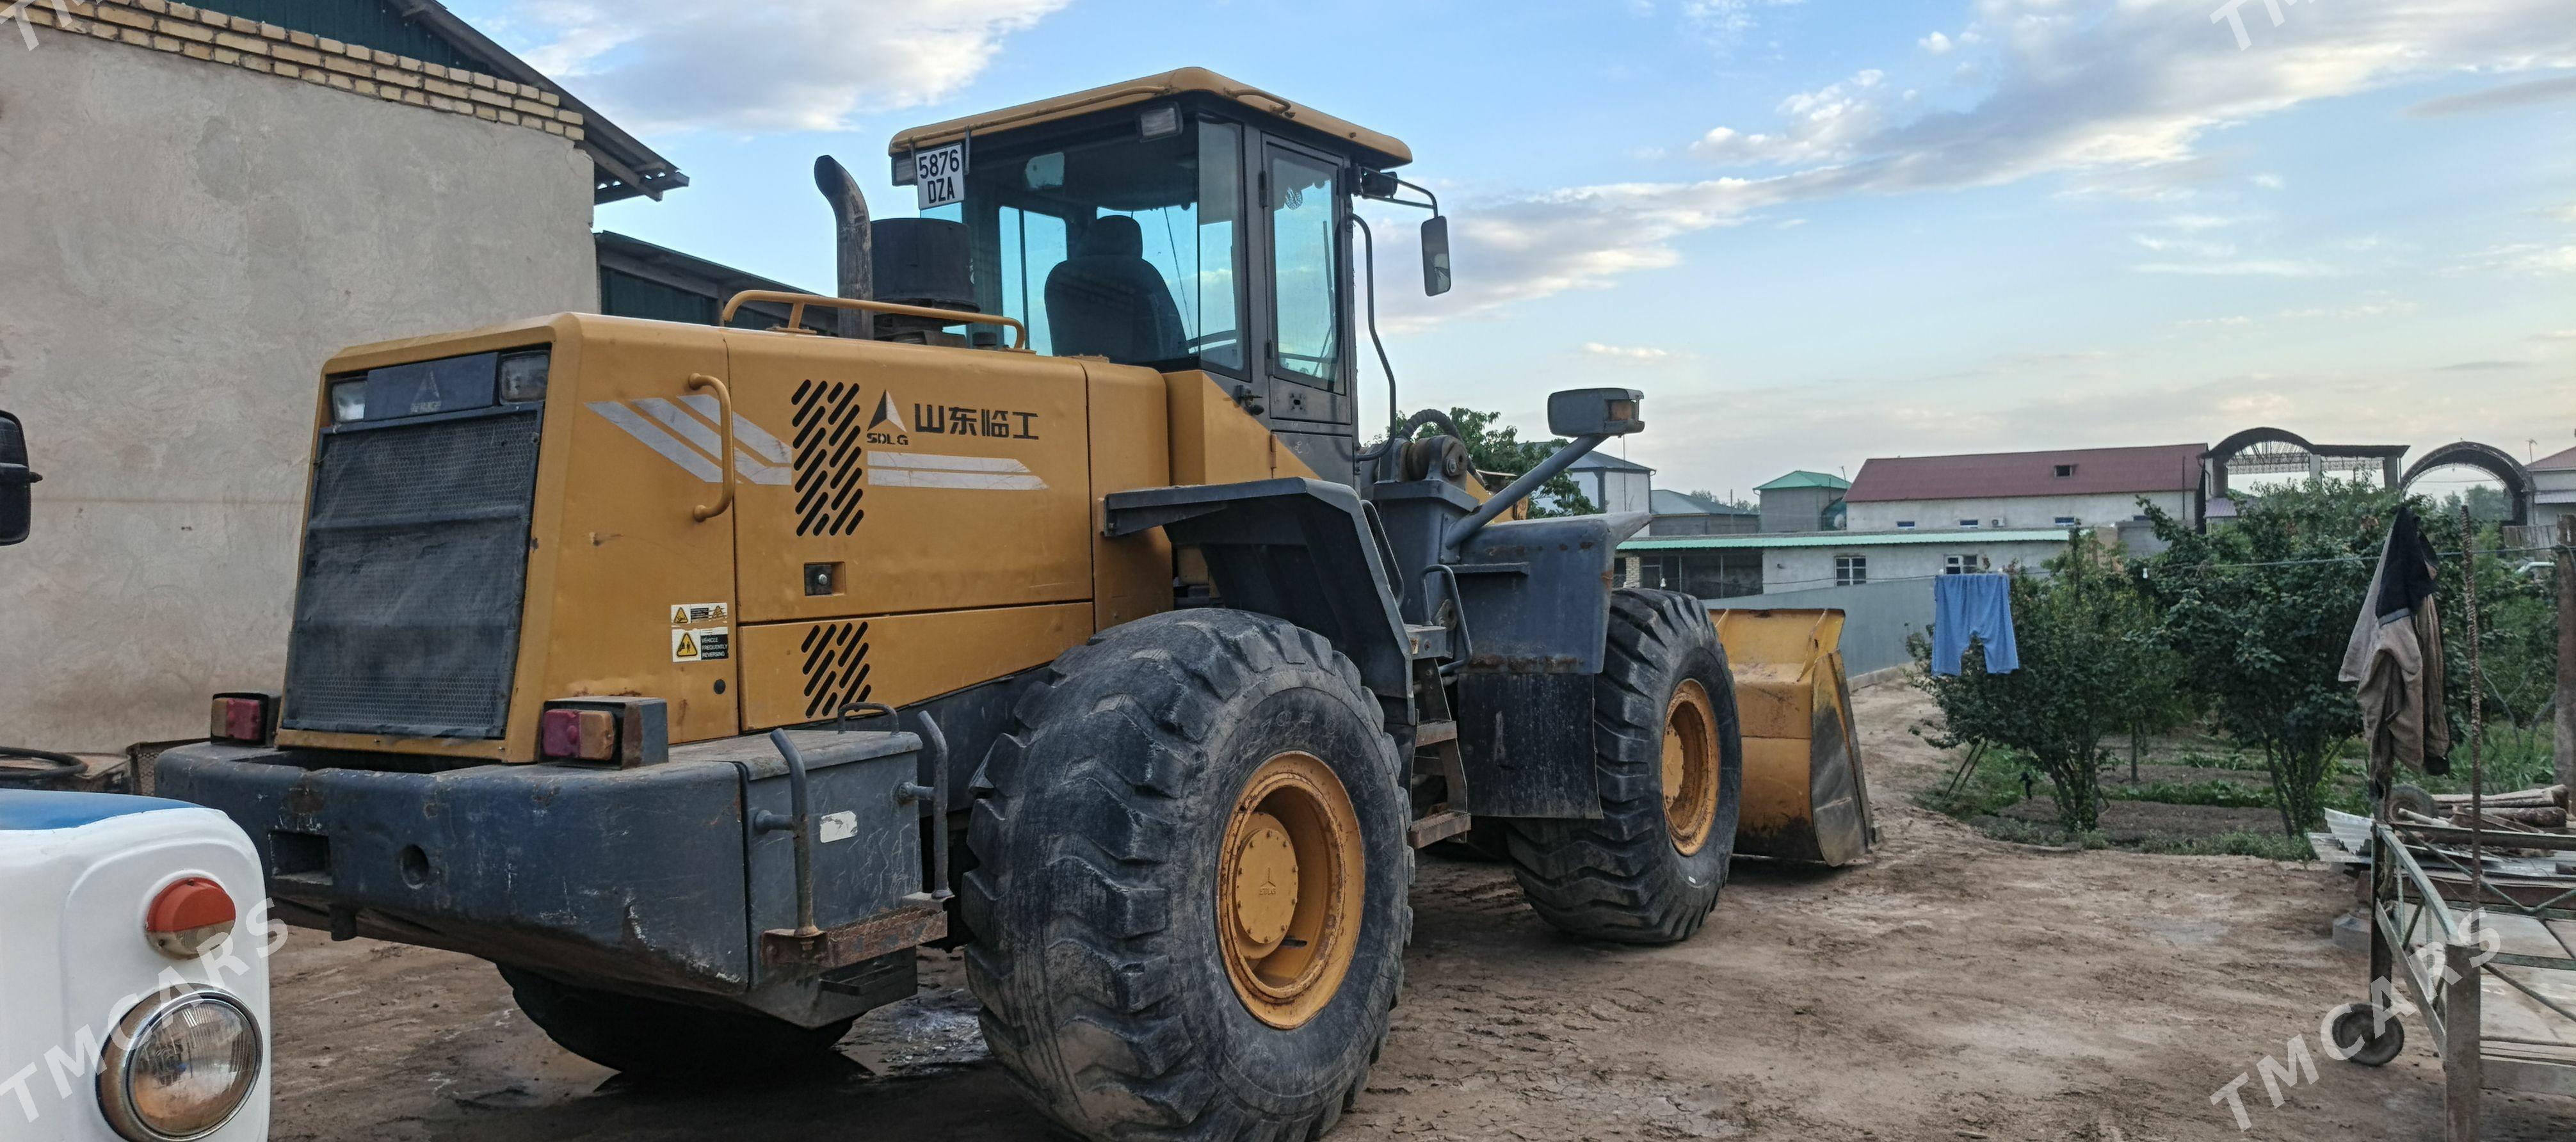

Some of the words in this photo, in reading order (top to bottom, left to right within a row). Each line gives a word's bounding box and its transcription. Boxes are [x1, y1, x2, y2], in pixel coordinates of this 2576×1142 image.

[919, 149, 960, 179] 5876
[928, 176, 955, 204] DZA
[914, 403, 1040, 440] 山东临工
[867, 433, 908, 446] SDLG
